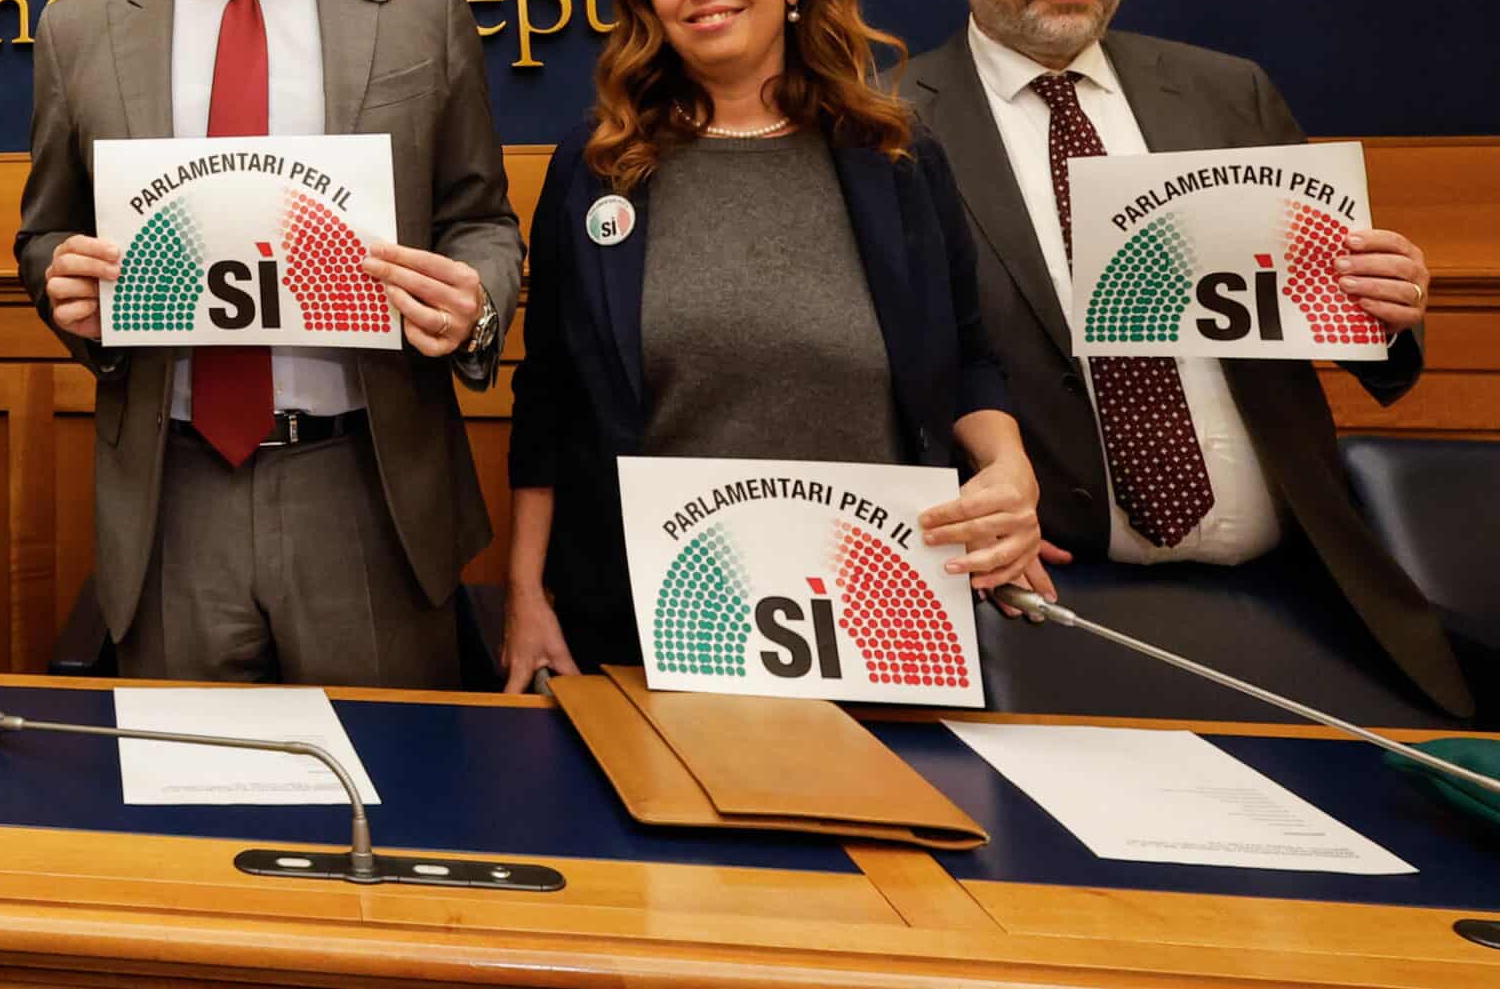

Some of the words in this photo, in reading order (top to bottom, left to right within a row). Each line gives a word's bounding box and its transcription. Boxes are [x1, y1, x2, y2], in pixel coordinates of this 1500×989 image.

[129, 152, 285, 215] PARLAMENTARI
[289, 161, 332, 195] PER
[331, 186, 353, 212] IL
[1111, 165, 1283, 232] PARLAMENTARI
[1289, 172, 1335, 205] PER
[1339, 195, 1357, 221] IL
[207, 242, 281, 330] SÌ
[1195, 253, 1284, 341] SÌ
[662, 477, 833, 540] PARLAMENTARI
[839, 491, 889, 529] PER
[890, 522, 914, 550] IL
[755, 577, 843, 680] SÌ
